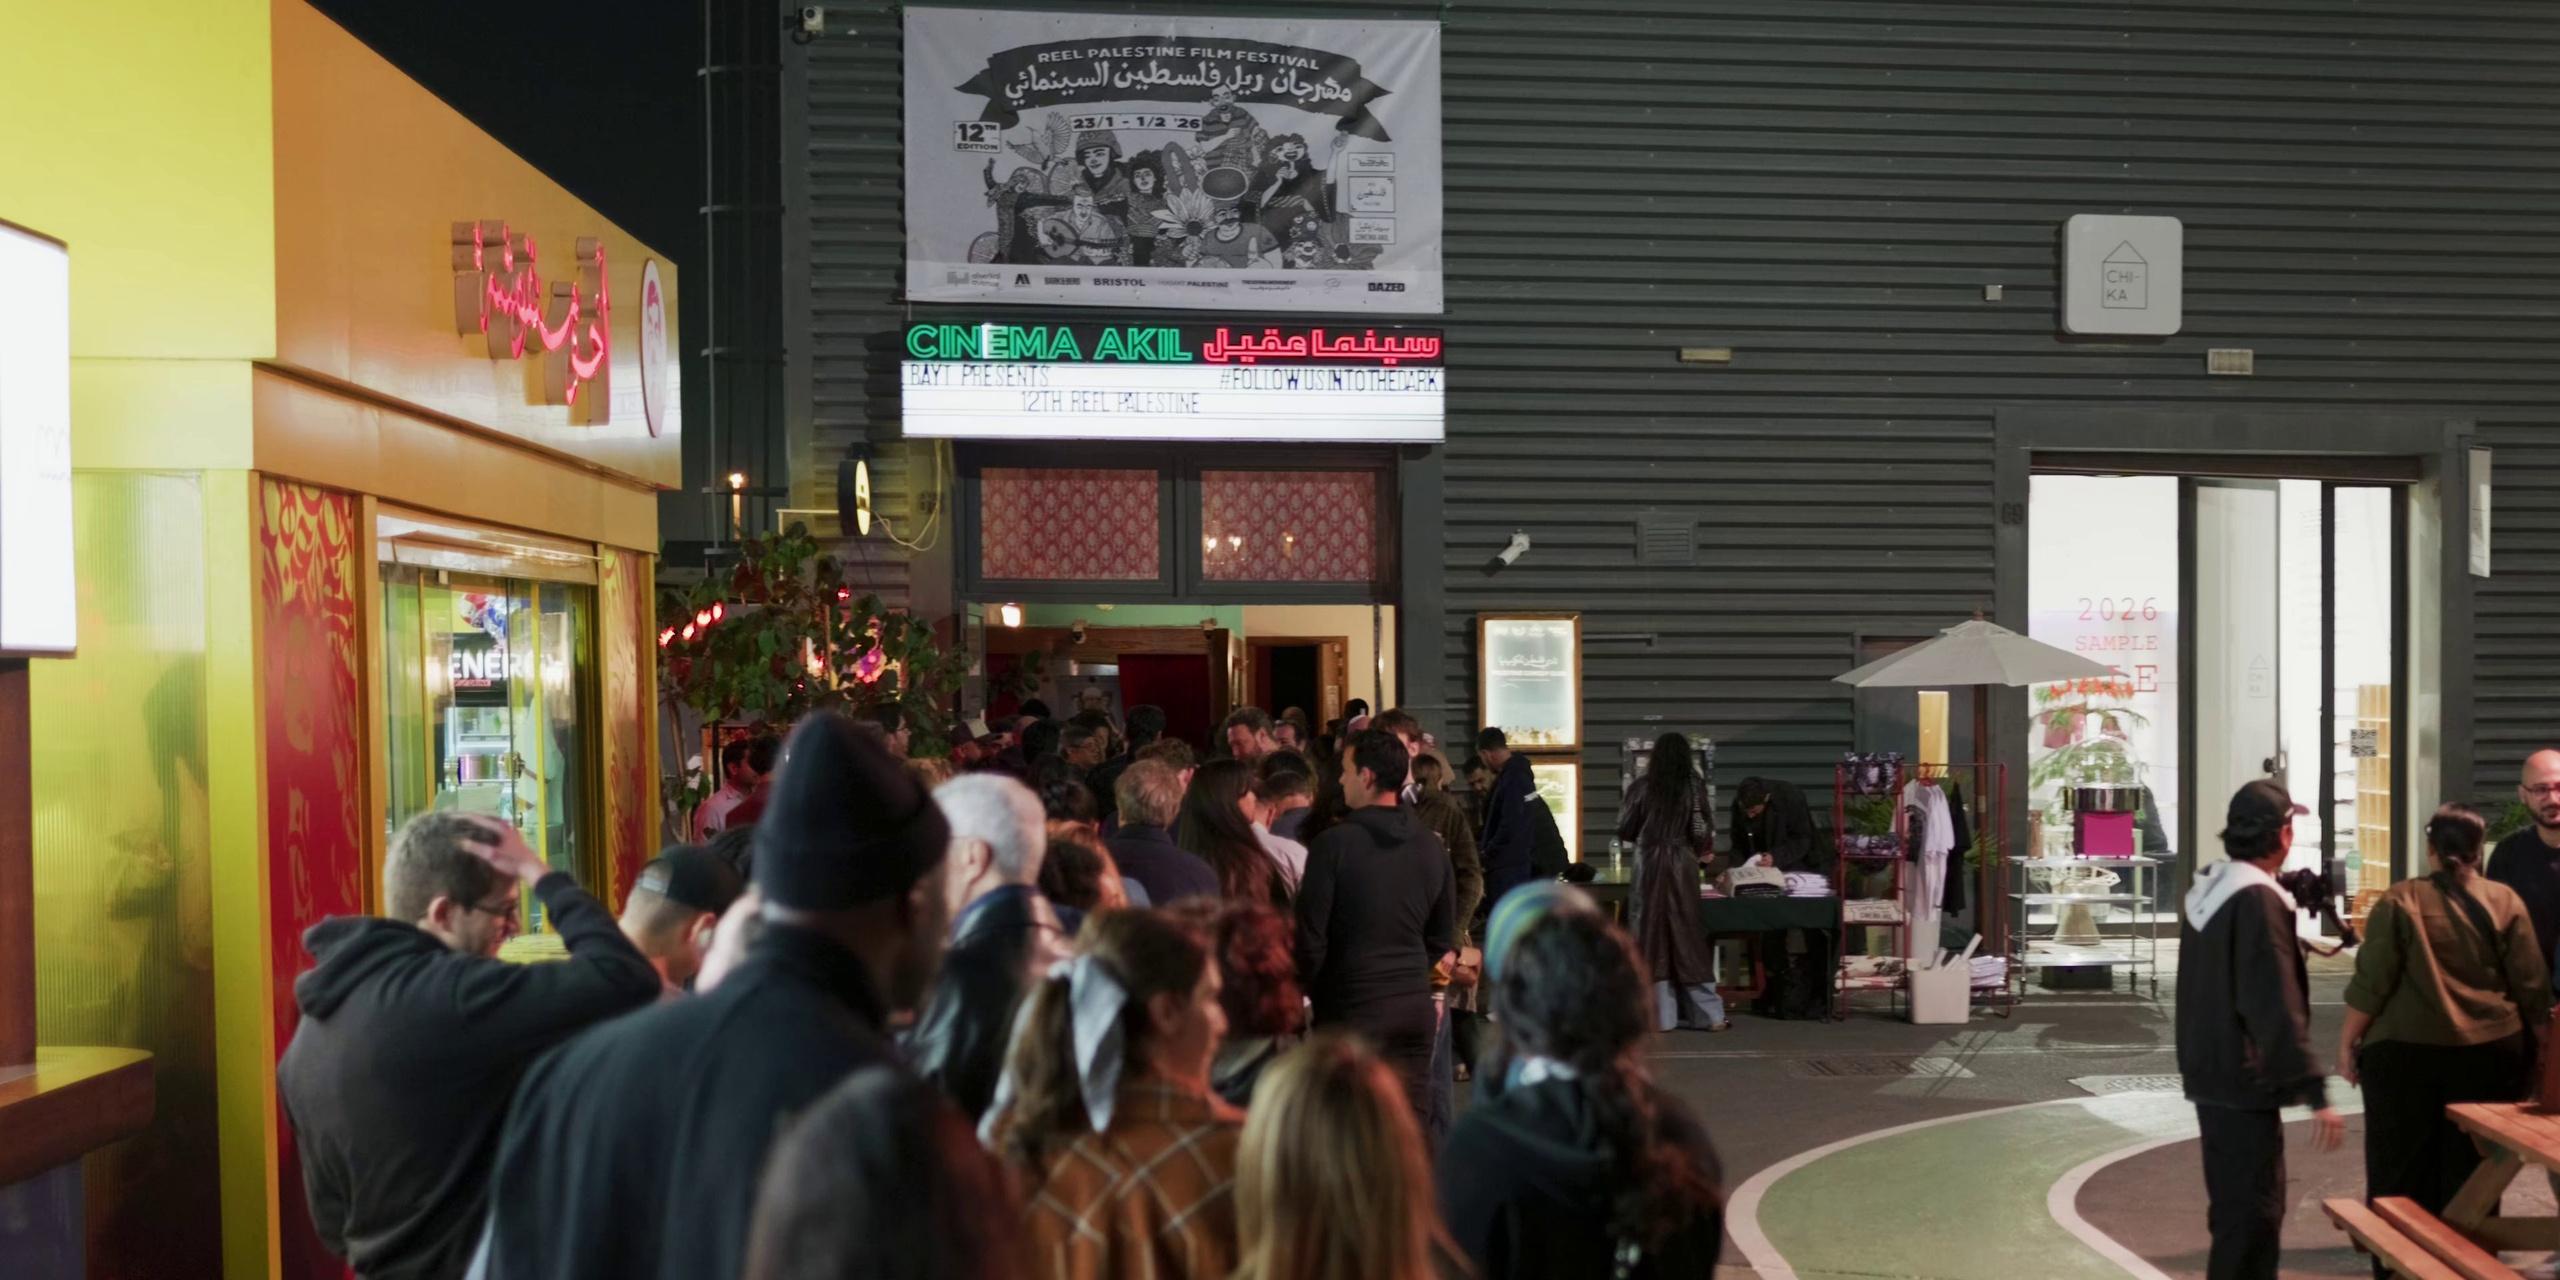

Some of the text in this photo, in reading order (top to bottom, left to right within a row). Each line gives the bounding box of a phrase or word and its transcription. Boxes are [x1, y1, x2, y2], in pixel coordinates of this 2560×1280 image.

[1038, 46, 1319, 70] REEL PALESTINE FILM FESTIVAL
[1005, 58, 1352, 106] مهرجان ريل فلسطين السينمائي
[1073, 115, 1114, 129] 23/1
[1136, 116, 1166, 128] 1/2
[1174, 117, 1200, 129] '26
[958, 123, 998, 142] 12TH
[957, 142, 998, 151] EDITION
[971, 271, 1001, 280] alserkal
[1093, 277, 1146, 287] BRISTOL
[2106, 269, 2141, 284] CHI-
[971, 280, 1000, 288] avenue
[1186, 280, 1229, 288] PALESTINE
[1367, 282, 1406, 292] DAZED
[2106, 288, 2129, 301] KA
[906, 323, 1193, 361] CINEMA AKIL
[1203, 327, 1440, 365] سينما عقيل
[910, 363, 1051, 388] BAYT PRESENTS
[1021, 390, 1200, 413] 12TH REEL PALESTINE
[2078, 597, 2158, 621] 2026
[2075, 635, 2158, 651] SAMPLE
